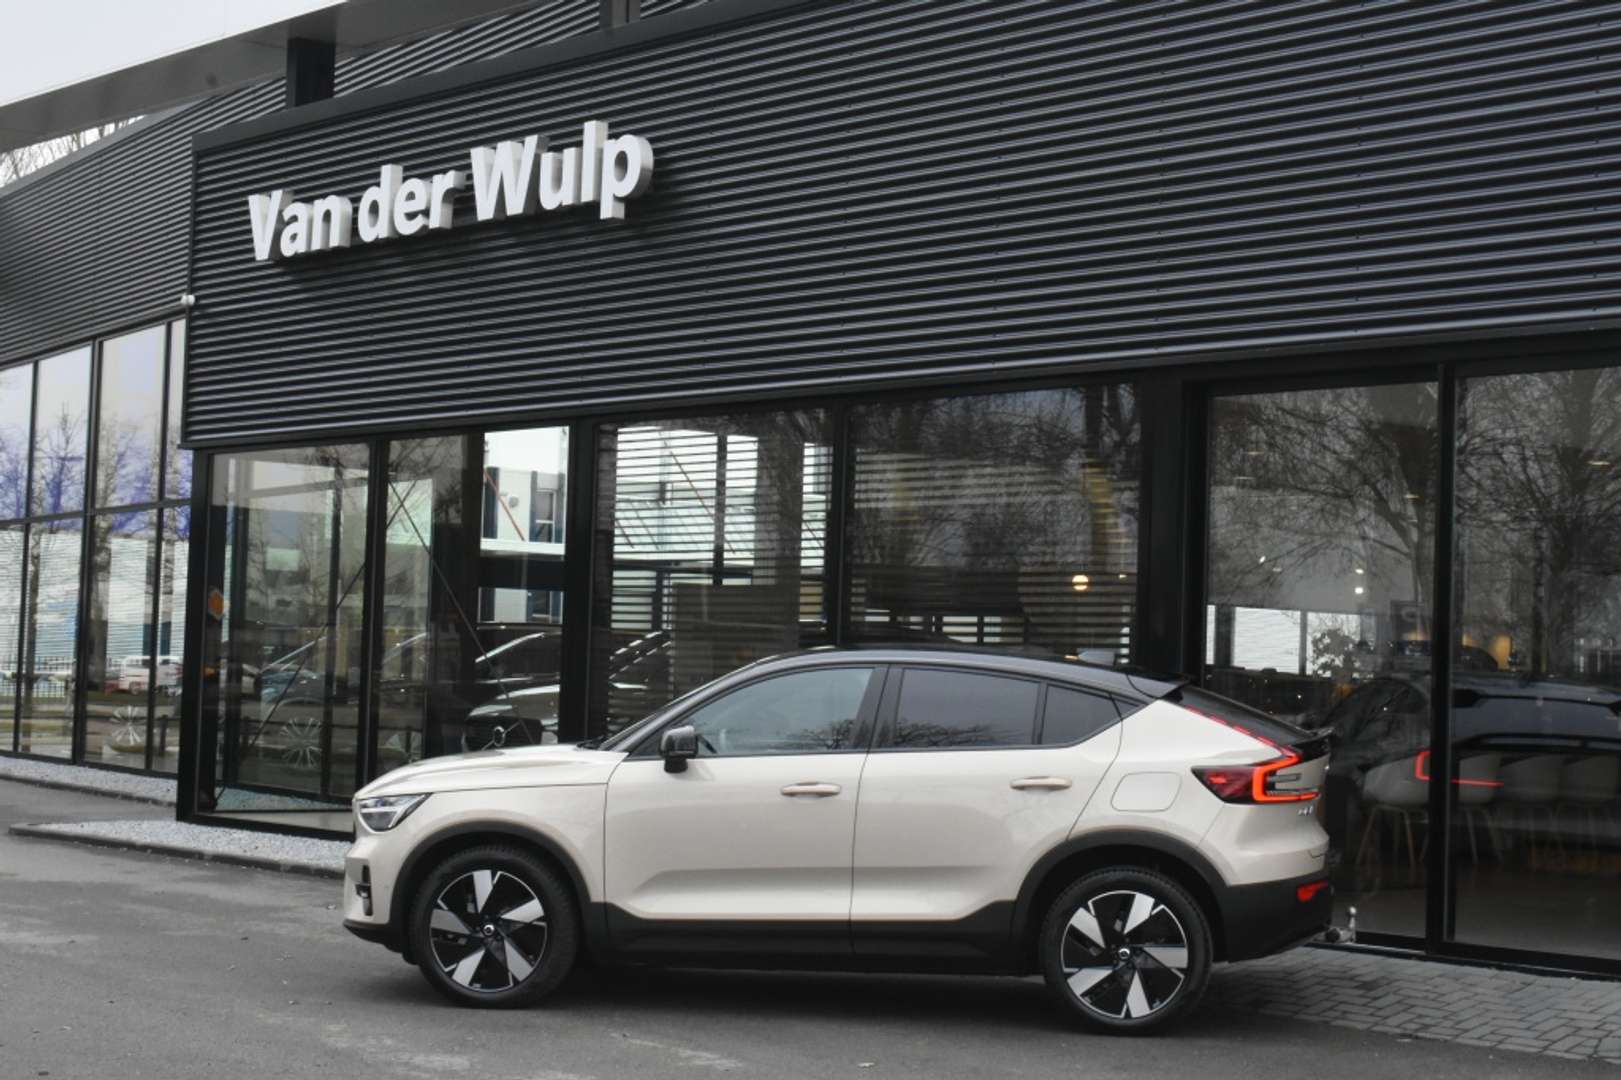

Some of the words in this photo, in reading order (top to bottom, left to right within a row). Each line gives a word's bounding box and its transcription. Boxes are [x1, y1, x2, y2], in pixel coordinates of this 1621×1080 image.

[248, 189, 352, 262] Van
[358, 163, 465, 243] der
[470, 120, 655, 221] Wulp
